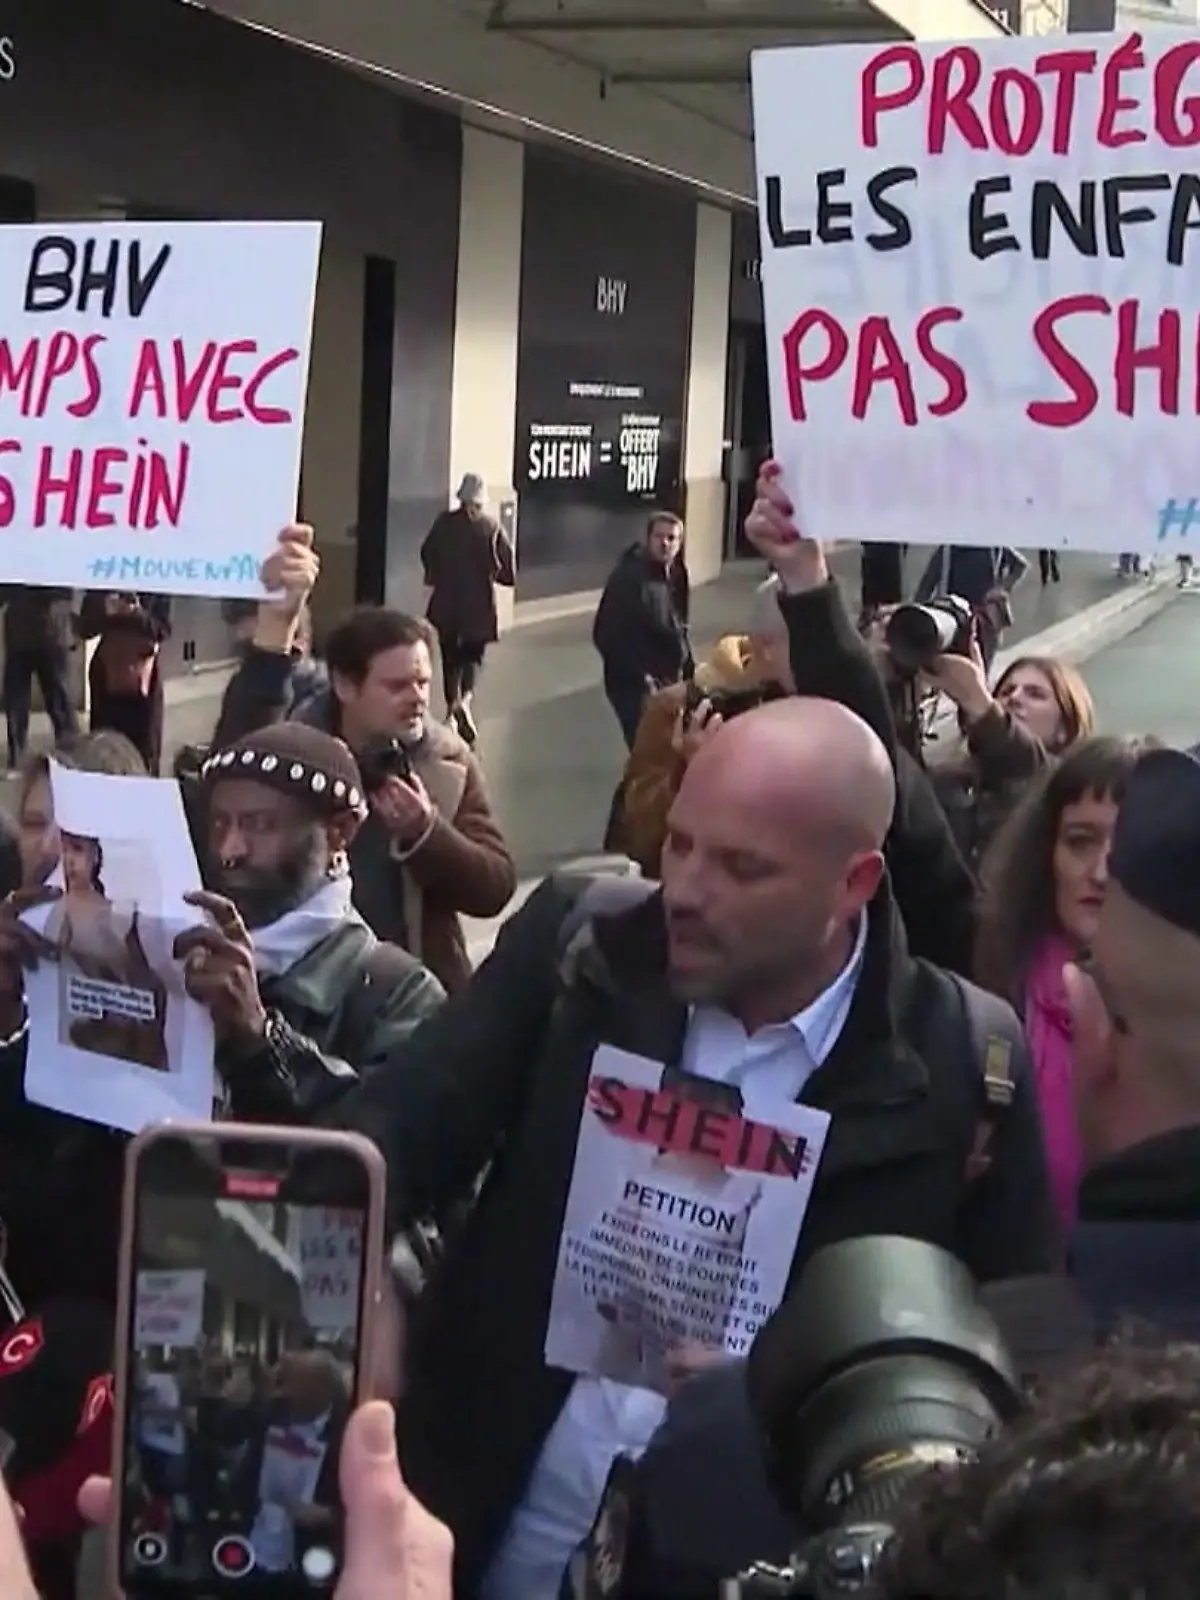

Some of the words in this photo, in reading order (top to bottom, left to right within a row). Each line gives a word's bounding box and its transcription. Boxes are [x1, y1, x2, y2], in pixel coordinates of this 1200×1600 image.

[861, 32, 1200, 156] PROTÉG
[765, 166, 917, 251] LES
[23, 235, 171, 318] BHV
[597, 275, 627, 315] BHV
[128, 339, 299, 424] AVEC
[783, 308, 967, 426] PAS
[1026, 295, 1200, 428] SH
[528, 441, 592, 480] SHEIN
[620, 429, 660, 453] OFFERT
[627, 455, 658, 492] BHV
[593, 1076, 808, 1181] SHEIN
[624, 1180, 736, 1234] PETITION
